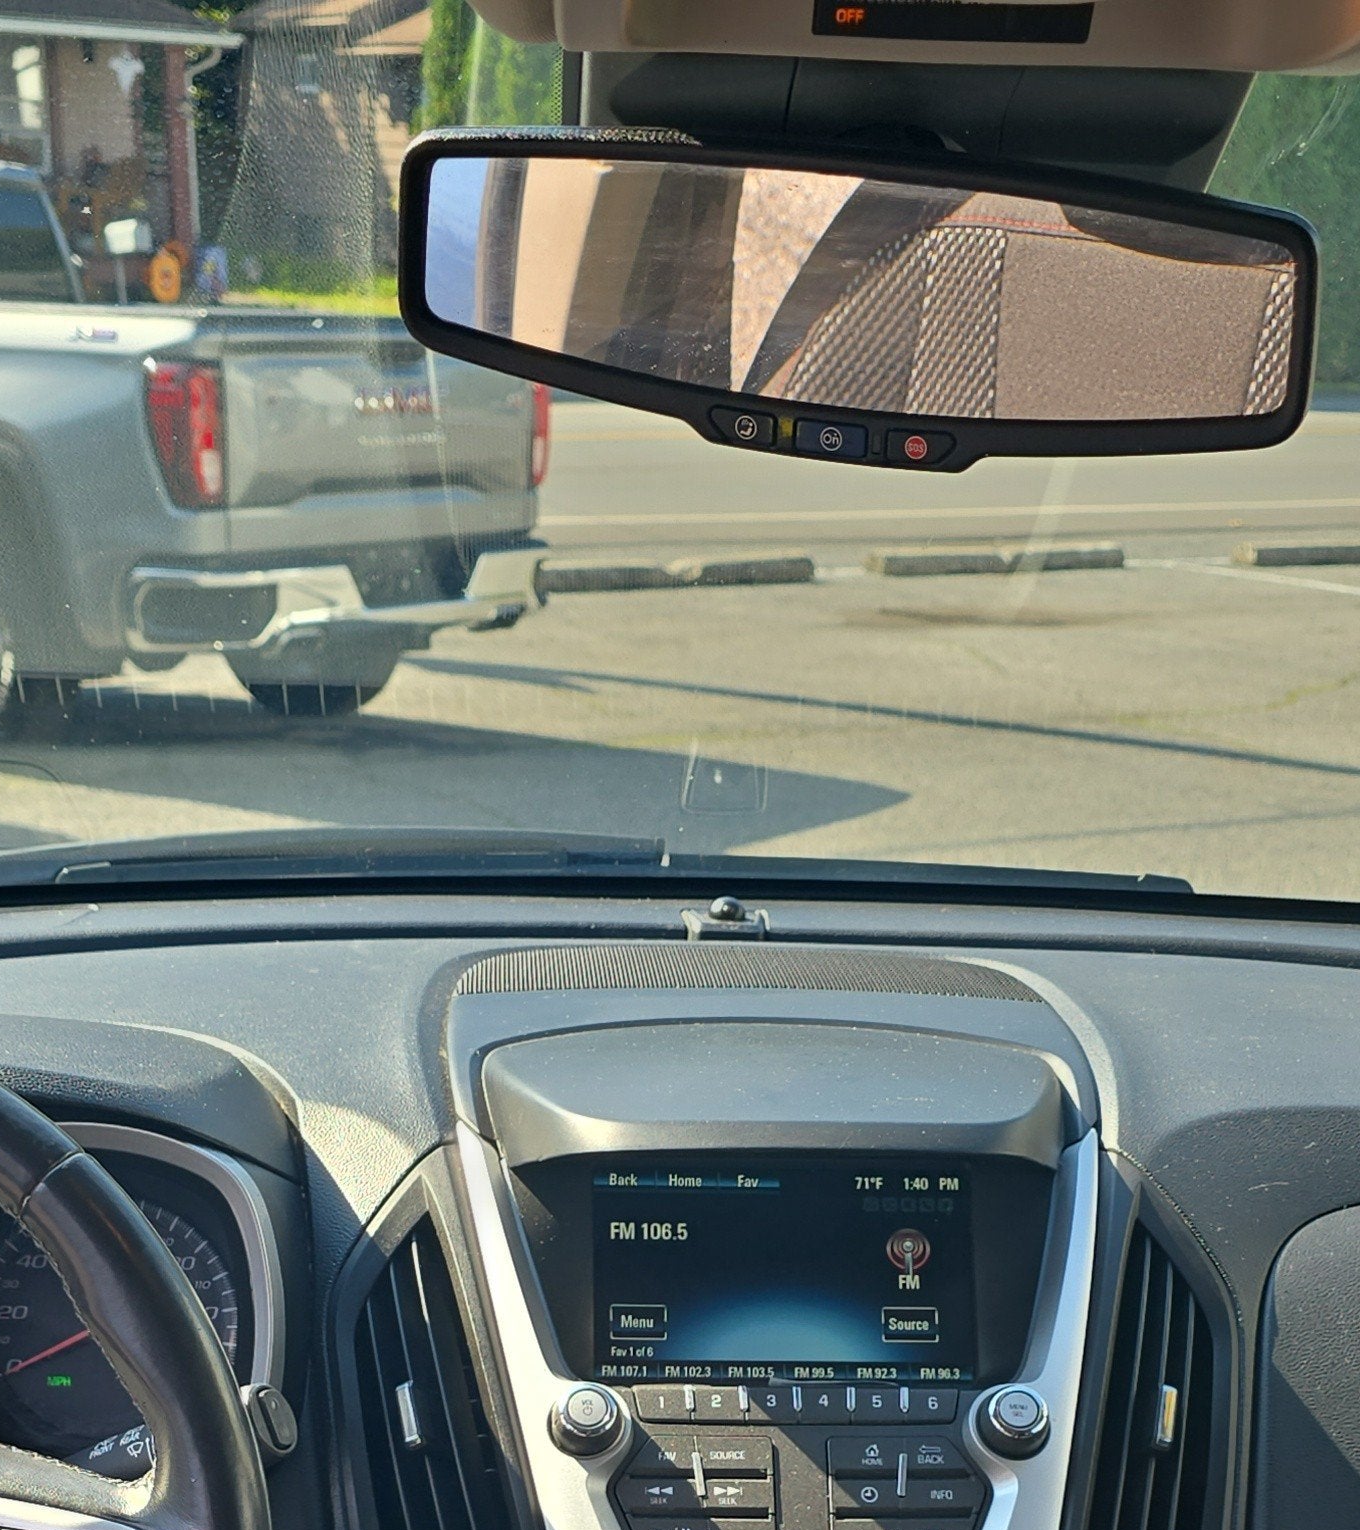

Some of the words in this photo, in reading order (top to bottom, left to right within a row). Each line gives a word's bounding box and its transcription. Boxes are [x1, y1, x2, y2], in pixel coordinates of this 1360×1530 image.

[835, 8, 865, 24] OFF
[907, 442, 925, 453] SOS
[609, 1173, 638, 1186] Back
[668, 1173, 702, 1188] Home
[737, 1174, 759, 1188] Fav
[855, 1176, 884, 1190] 71°F
[903, 1177, 929, 1191] 1:40
[939, 1177, 959, 1191] PM
[610, 1221, 636, 1241] FM
[641, 1222, 688, 1241] 106.5
[16, 1254, 48, 1269] 40
[1, 1279, 20, 1289] 30
[898, 1274, 921, 1290] FM
[621, 1315, 655, 1329] Menu
[888, 1318, 930, 1331] Source
[611, 1346, 627, 1357] Fav
[629, 1346, 634, 1357] 1
[636, 1346, 645, 1357] of
[646, 1346, 654, 1357] 6
[602, 1365, 617, 1377] FM
[620, 1365, 647, 1377] 107.1
[665, 1366, 680, 1378] FM
[684, 1366, 711, 1378] 102.3
[728, 1366, 743, 1378] FM
[747, 1367, 775, 1378] 103.5
[794, 1367, 809, 1378] FM
[812, 1367, 834, 1379] 99.5
[857, 1368, 872, 1379] FM
[874, 1368, 897, 1379] 92.3
[920, 1368, 935, 1380] FM
[47, 1376, 72, 1387] MPH
[658, 1395, 665, 1409] 1
[711, 1394, 722, 1408] 2
[766, 1394, 777, 1407] 3
[818, 1394, 829, 1407] 4
[872, 1395, 882, 1408] 5
[928, 1396, 939, 1410] 6
[658, 1451, 677, 1462] FAV
[709, 1450, 746, 1460] SOURCE
[917, 1454, 944, 1465] BACK
[861, 1458, 883, 1466] HOME
[650, 1496, 668, 1505] SEEK
[718, 1496, 738, 1506] SEEK
[930, 1490, 953, 1500] INFO
